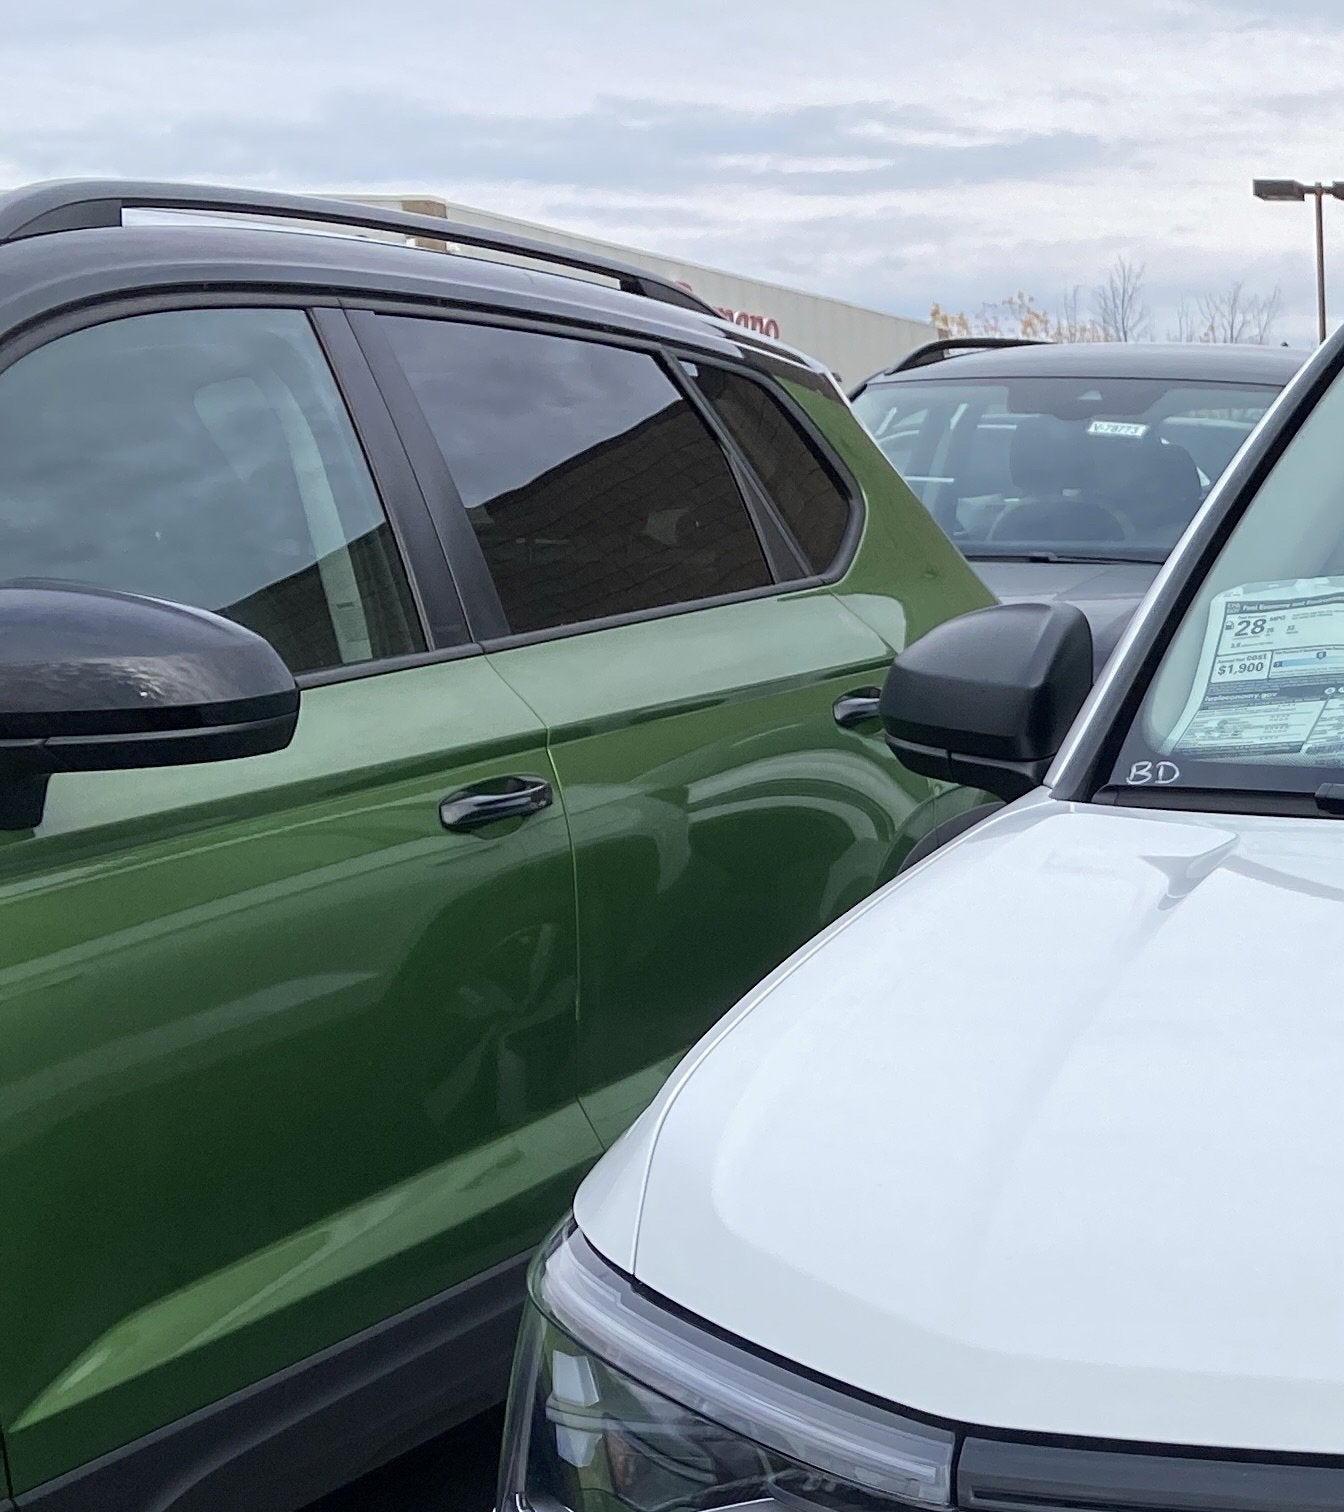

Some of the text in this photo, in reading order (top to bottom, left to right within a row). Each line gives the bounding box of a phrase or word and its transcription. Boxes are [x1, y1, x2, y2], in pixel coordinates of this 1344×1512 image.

[1234, 618, 1267, 637] 28
[1246, 653, 1267, 662] cost
[1217, 661, 1264, 676] $1,900
